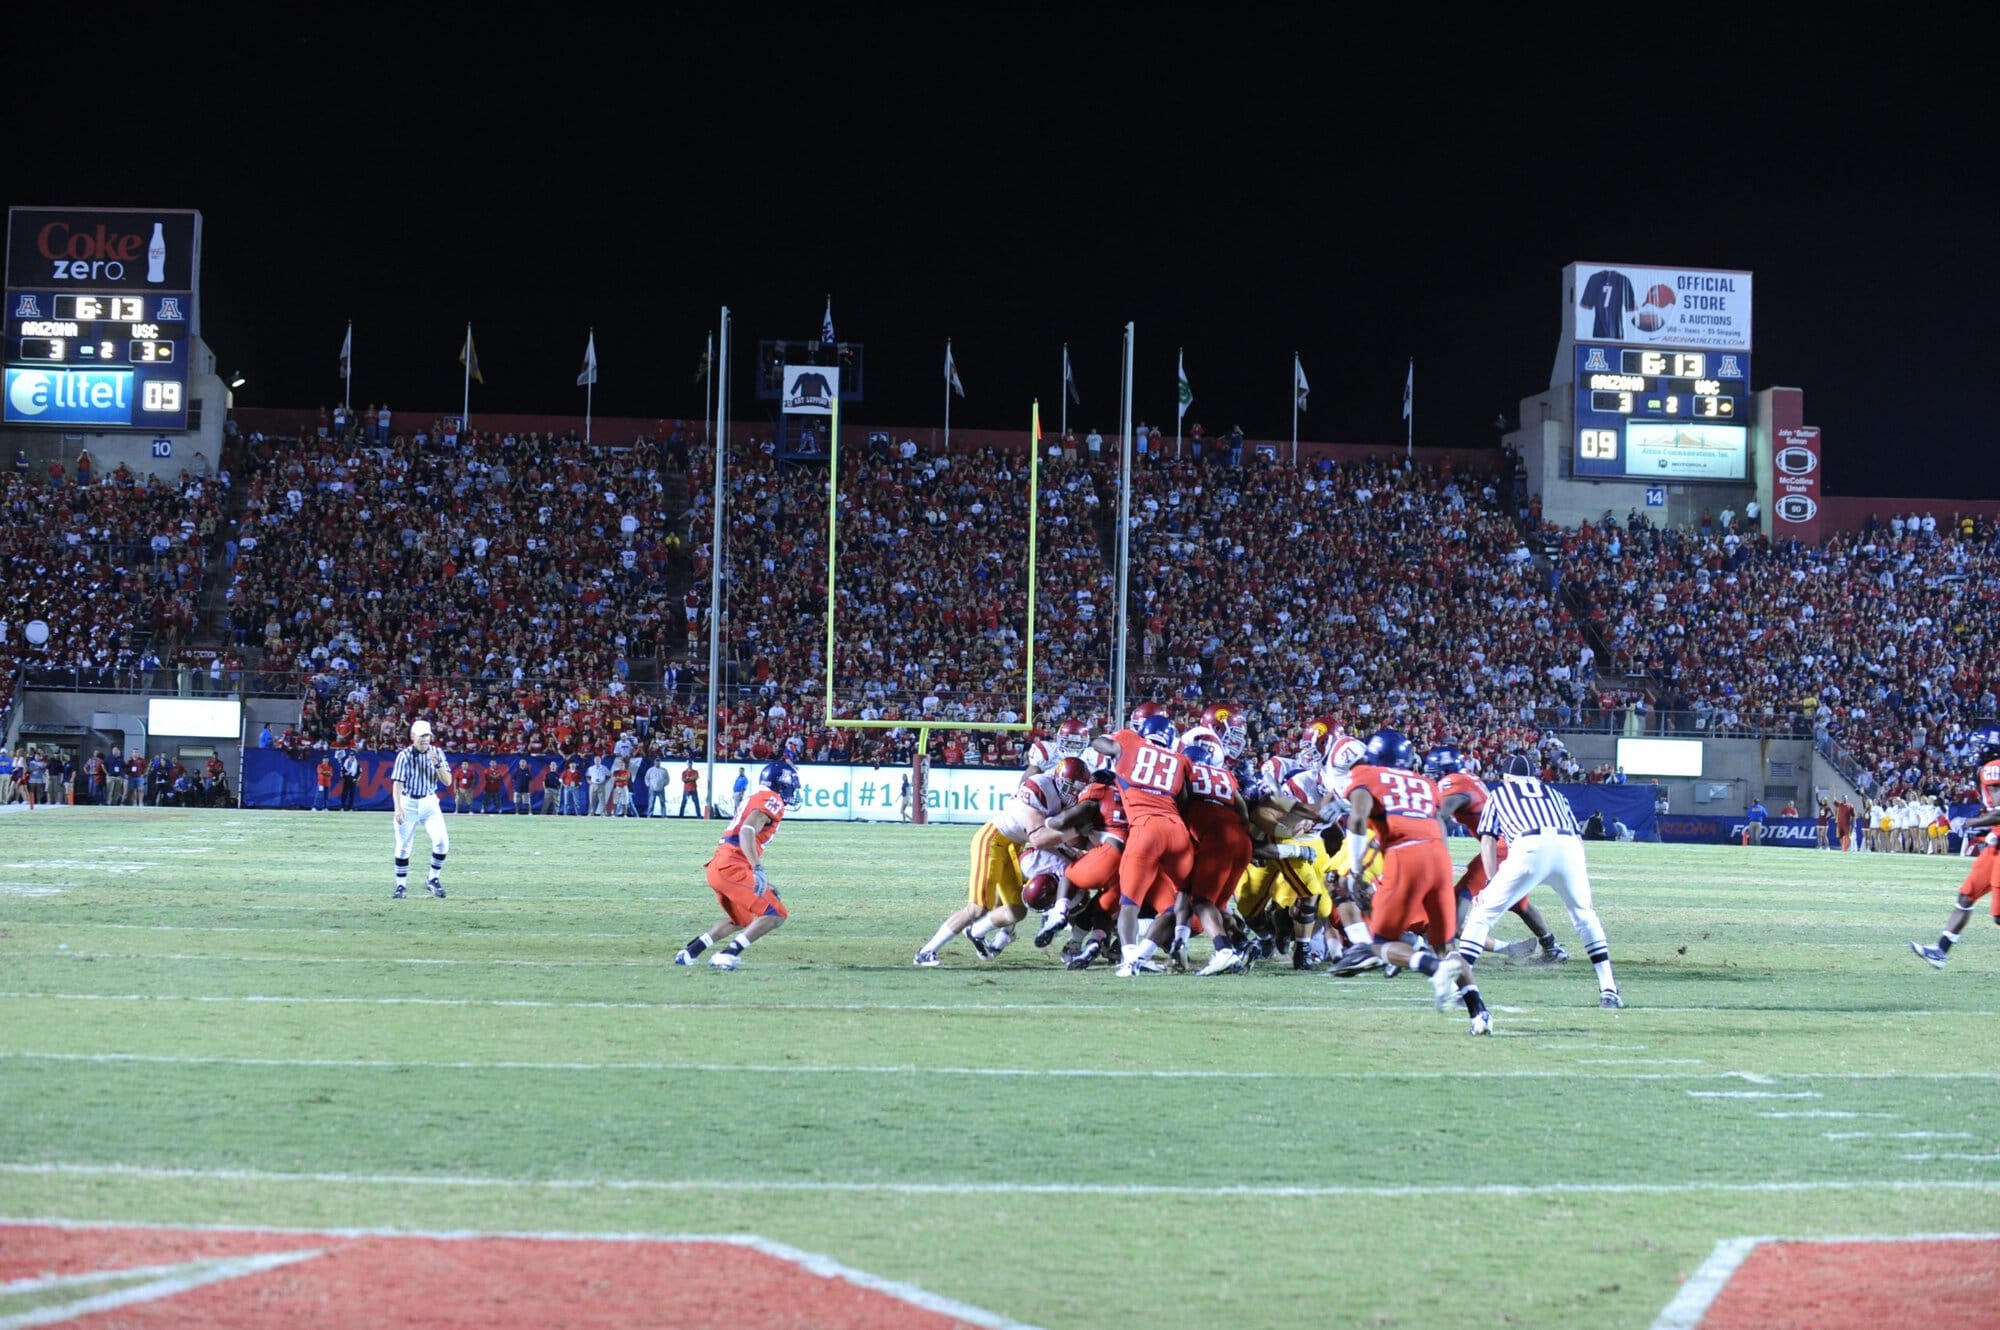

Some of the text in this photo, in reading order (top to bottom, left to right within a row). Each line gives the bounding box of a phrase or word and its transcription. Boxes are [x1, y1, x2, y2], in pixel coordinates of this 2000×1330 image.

[38, 222, 143, 260] Coke
[53, 260, 124, 280] zero
[1677, 276, 1736, 293] OFFICIAL
[1683, 295, 1726, 311] STORE
[21, 321, 78, 337] ARIZONA
[1688, 314, 1732, 326] AUCTIONS
[132, 323, 159, 339] USC
[49, 340, 64, 359] 3
[100, 341, 113, 358] 2
[141, 342, 155, 361] 3
[32, 370, 126, 409] alltel
[1618, 392, 1632, 413] 3
[1666, 396, 1678, 413] 2
[1704, 397, 1717, 416] 3
[1778, 429, 1792, 437] John
[154, 442, 171, 456] 10
[1647, 491, 1663, 504] 14
[1130, 746, 1178, 791] 83
[1983, 765, 2000, 780] 20
[1191, 765, 1232, 800] 33
[1515, 778, 1543, 798] U
[859, 781, 893, 807] #1
[912, 785, 979, 811] ank
[1380, 772, 1433, 816] 32
